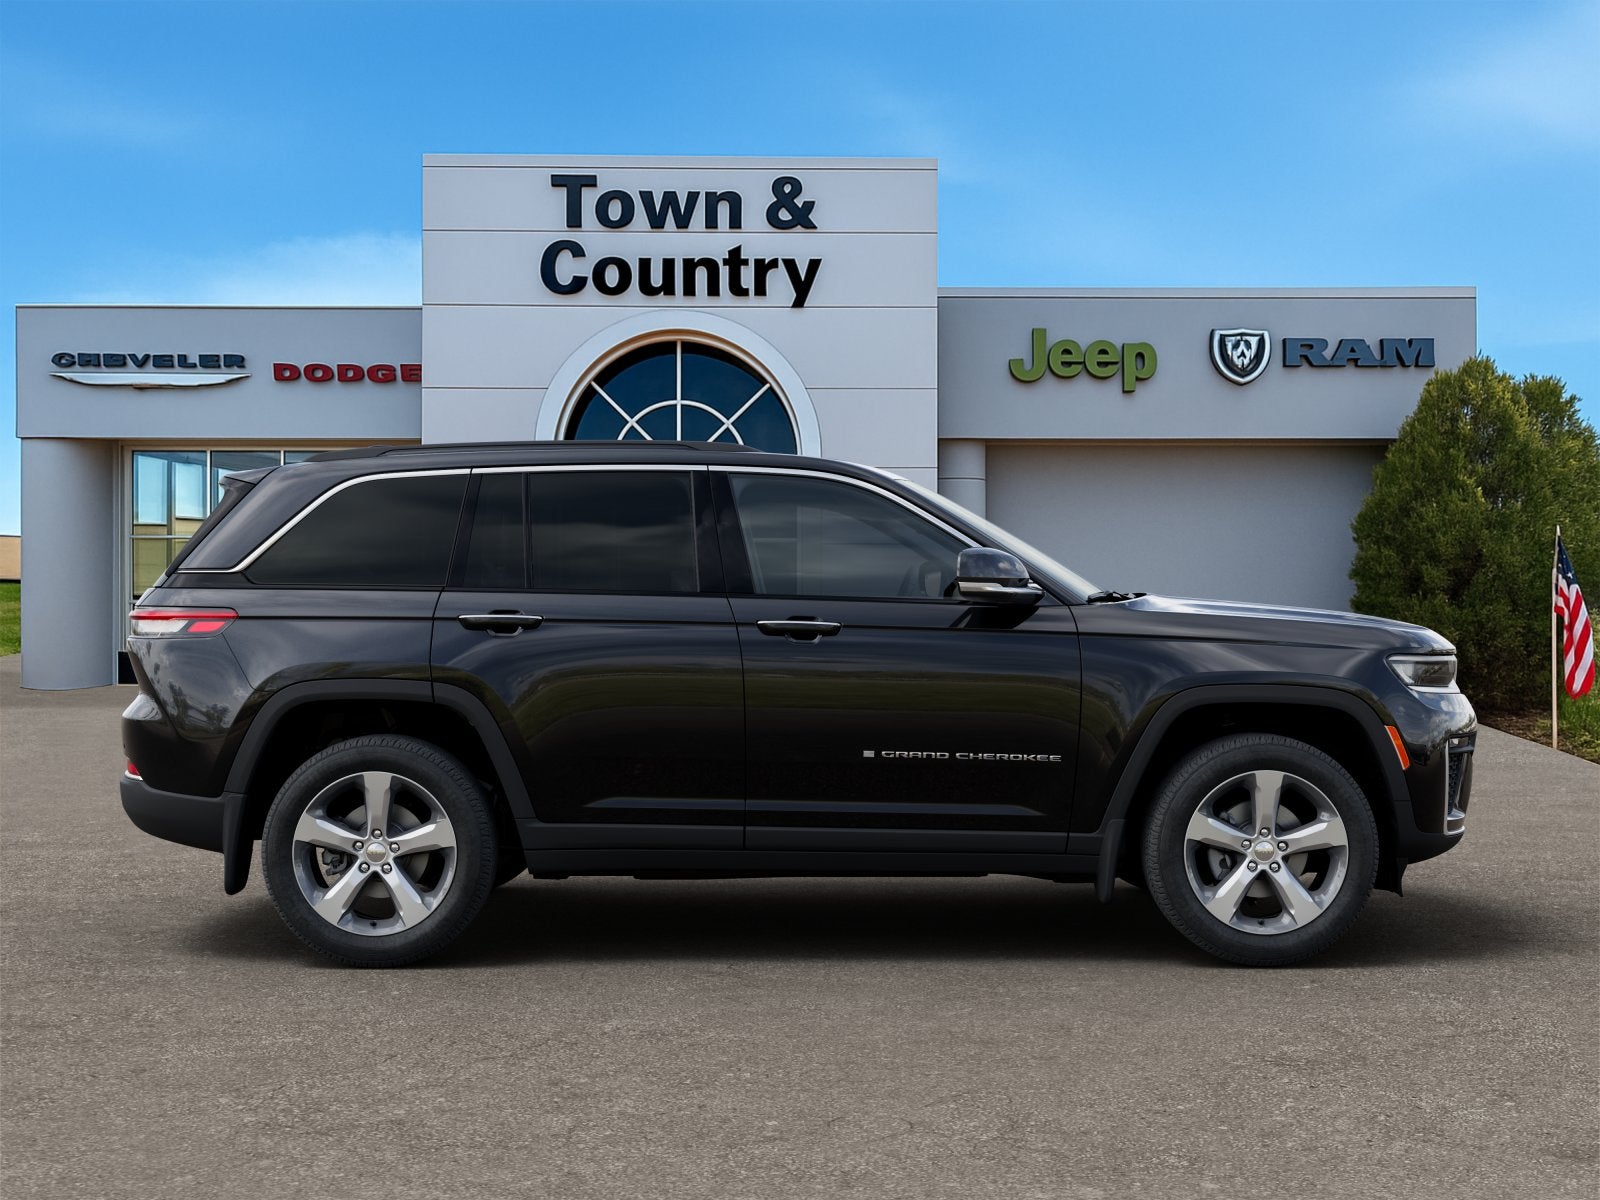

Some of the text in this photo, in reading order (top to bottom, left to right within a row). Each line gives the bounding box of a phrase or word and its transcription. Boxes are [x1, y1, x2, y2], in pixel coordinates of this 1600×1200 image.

[551, 174, 818, 231] Town &
[540, 239, 822, 308] Country
[272, 362, 422, 383] DODGE
[1009, 327, 1158, 393] Jeep
[1283, 337, 1436, 368] RAM
[881, 750, 1062, 762] GRAND CHEROKEE
